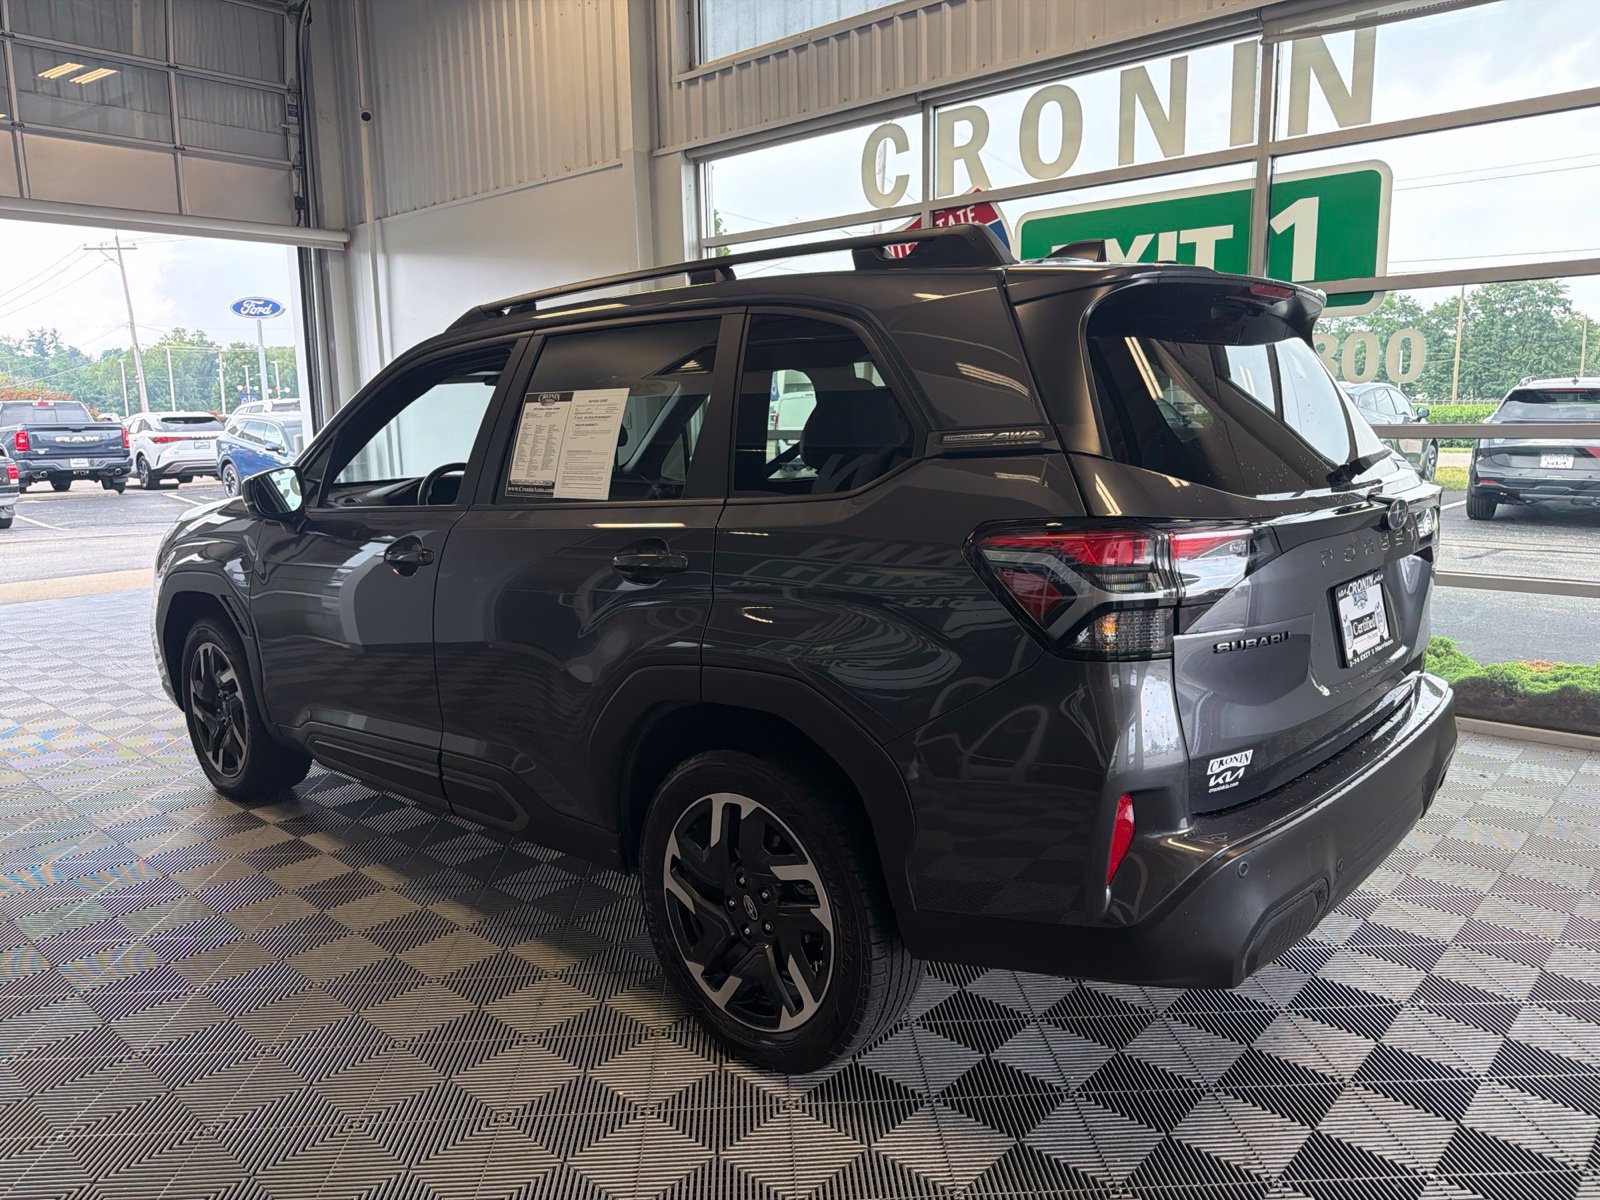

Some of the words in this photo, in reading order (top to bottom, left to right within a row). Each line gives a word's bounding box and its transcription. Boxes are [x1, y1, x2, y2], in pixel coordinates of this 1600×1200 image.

[861, 22, 1377, 209] CRONIN
[1270, 196, 1319, 283] 1
[240, 299, 272, 315] Ford
[1213, 631, 1291, 653] SUBARU
[1209, 752, 1251, 773] CRONIN
